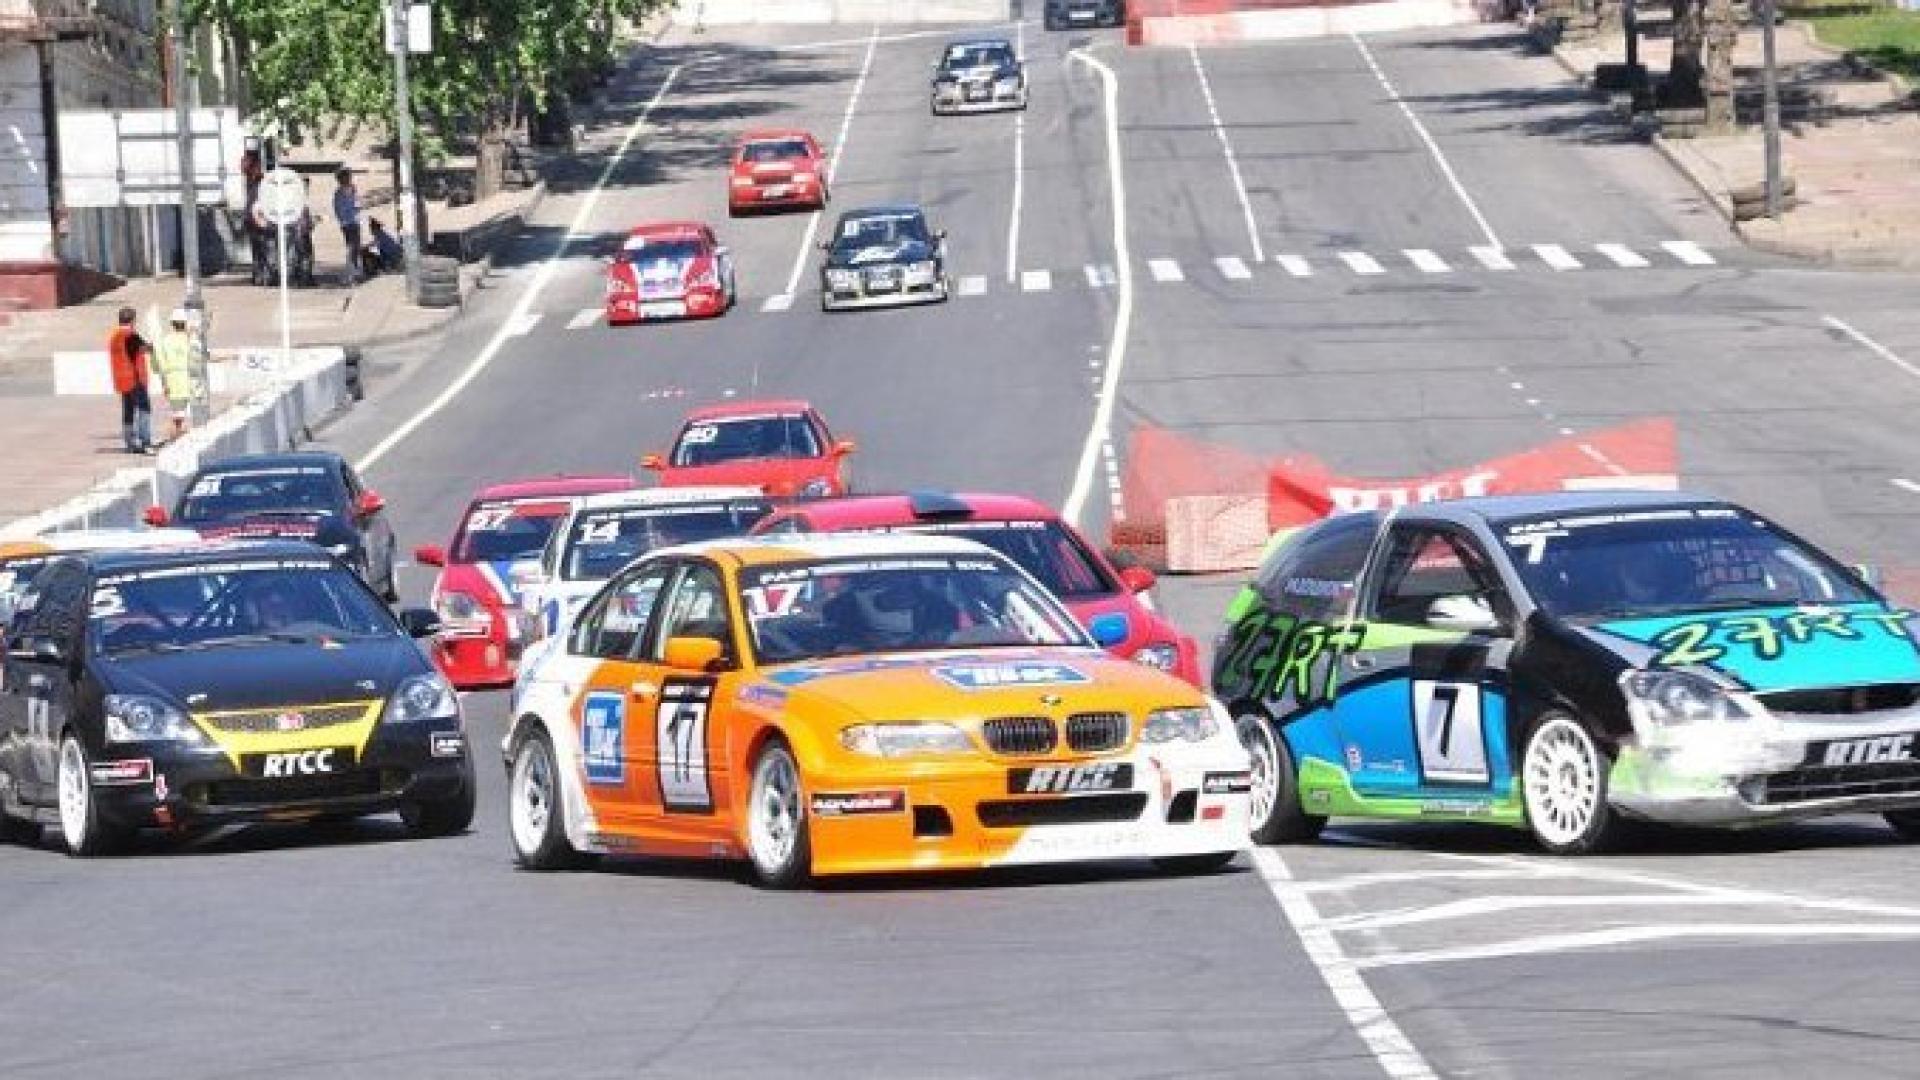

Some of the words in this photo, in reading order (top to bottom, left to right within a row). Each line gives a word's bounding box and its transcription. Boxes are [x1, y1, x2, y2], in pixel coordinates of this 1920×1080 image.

[742, 581, 800, 618] 17
[666, 709, 698, 783] 17
[1433, 687, 1461, 758] 7
[263, 749, 333, 777] RTCC
